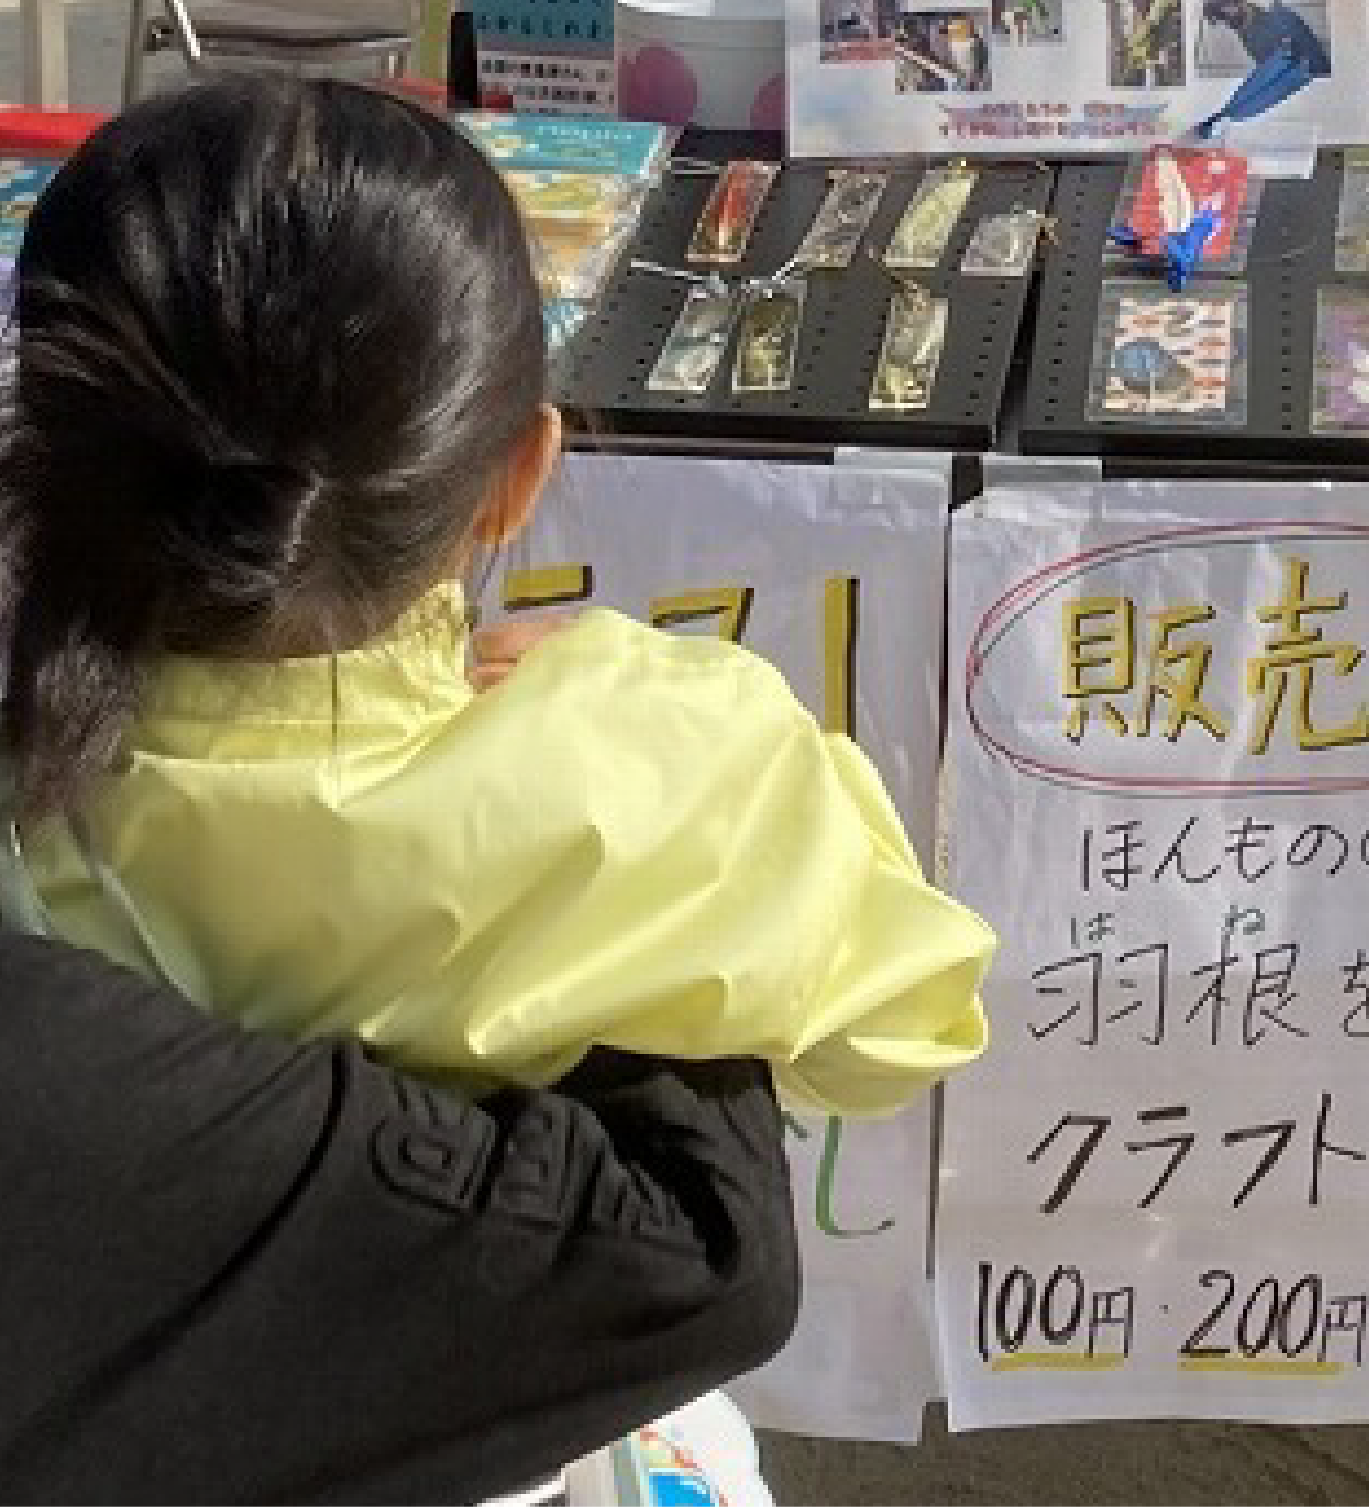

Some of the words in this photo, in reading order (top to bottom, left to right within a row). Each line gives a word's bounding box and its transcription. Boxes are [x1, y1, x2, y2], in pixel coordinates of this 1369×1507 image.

[1028, 1092, 1367, 1214] クラフト
[978, 1259, 1137, 1361] 100円
[1179, 1269, 1368, 1367] 200円
